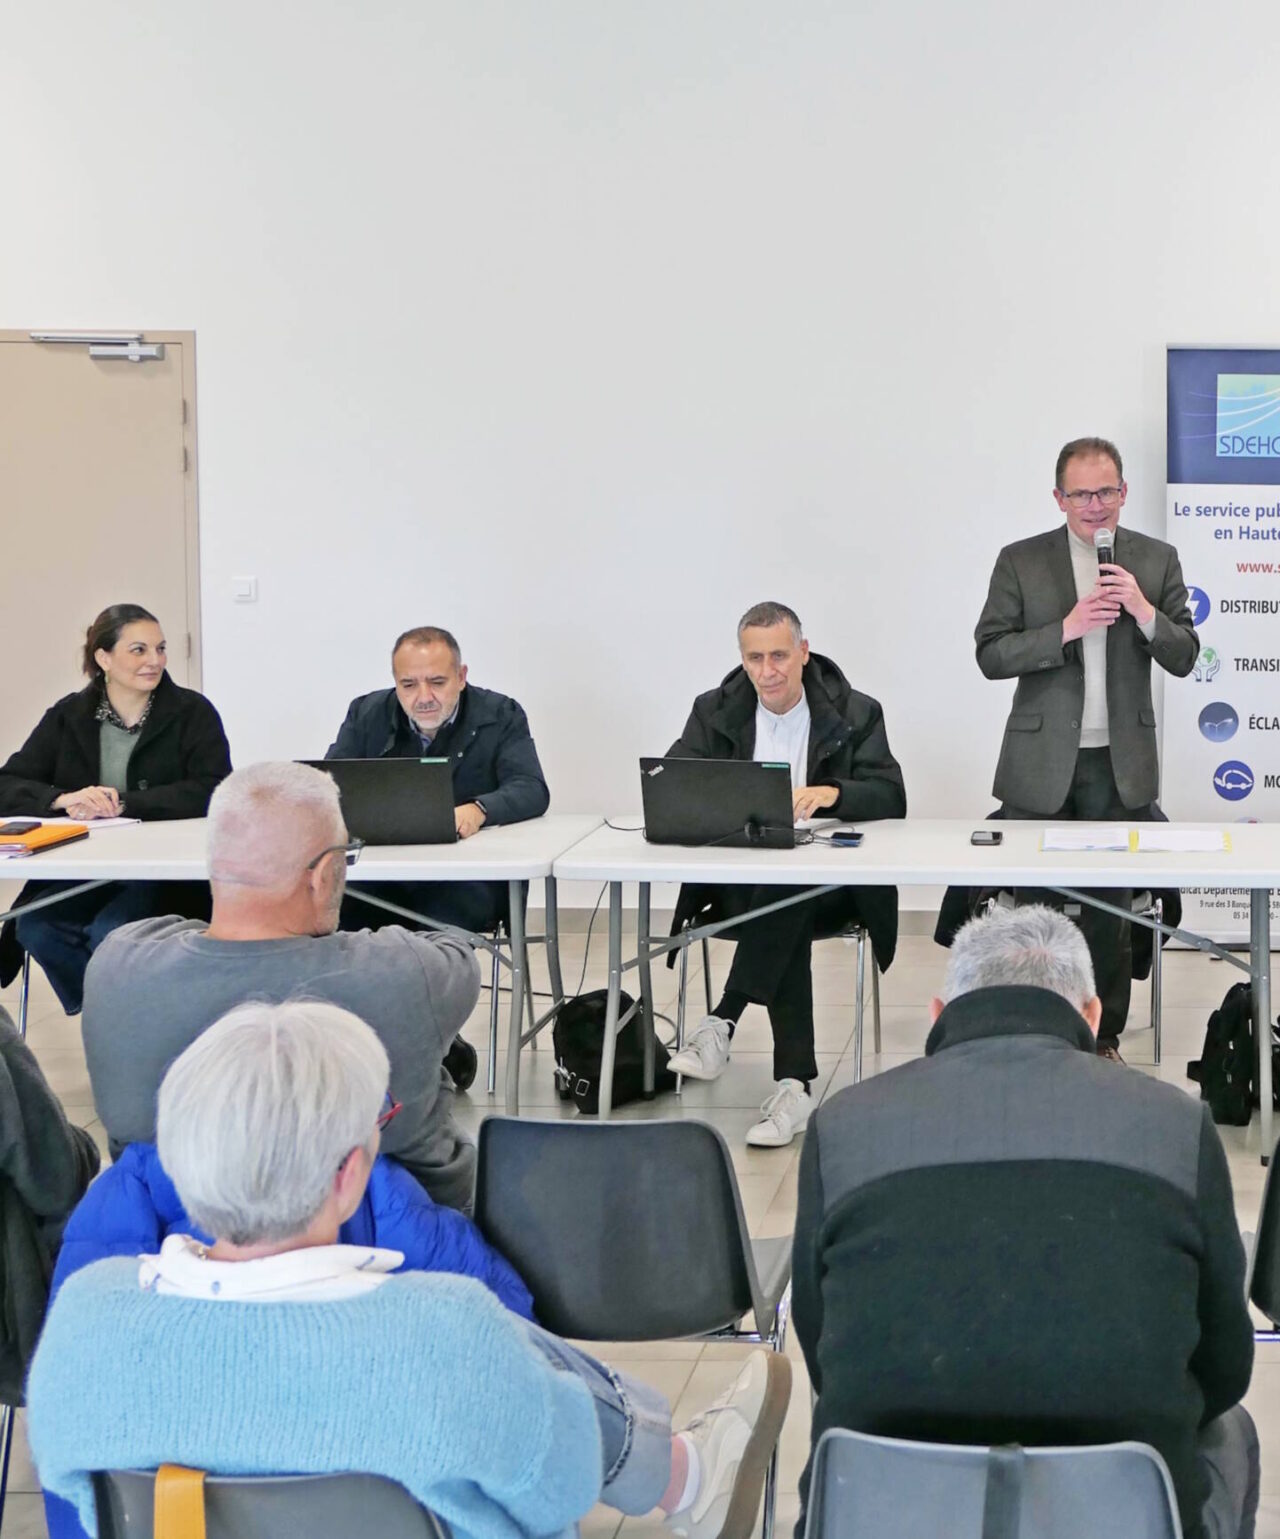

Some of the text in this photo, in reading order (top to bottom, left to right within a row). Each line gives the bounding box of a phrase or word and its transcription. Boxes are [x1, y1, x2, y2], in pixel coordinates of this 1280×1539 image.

[1174, 502, 1191, 517] Le
[1195, 502, 1251, 518] service
[1213, 529, 1233, 540] en
